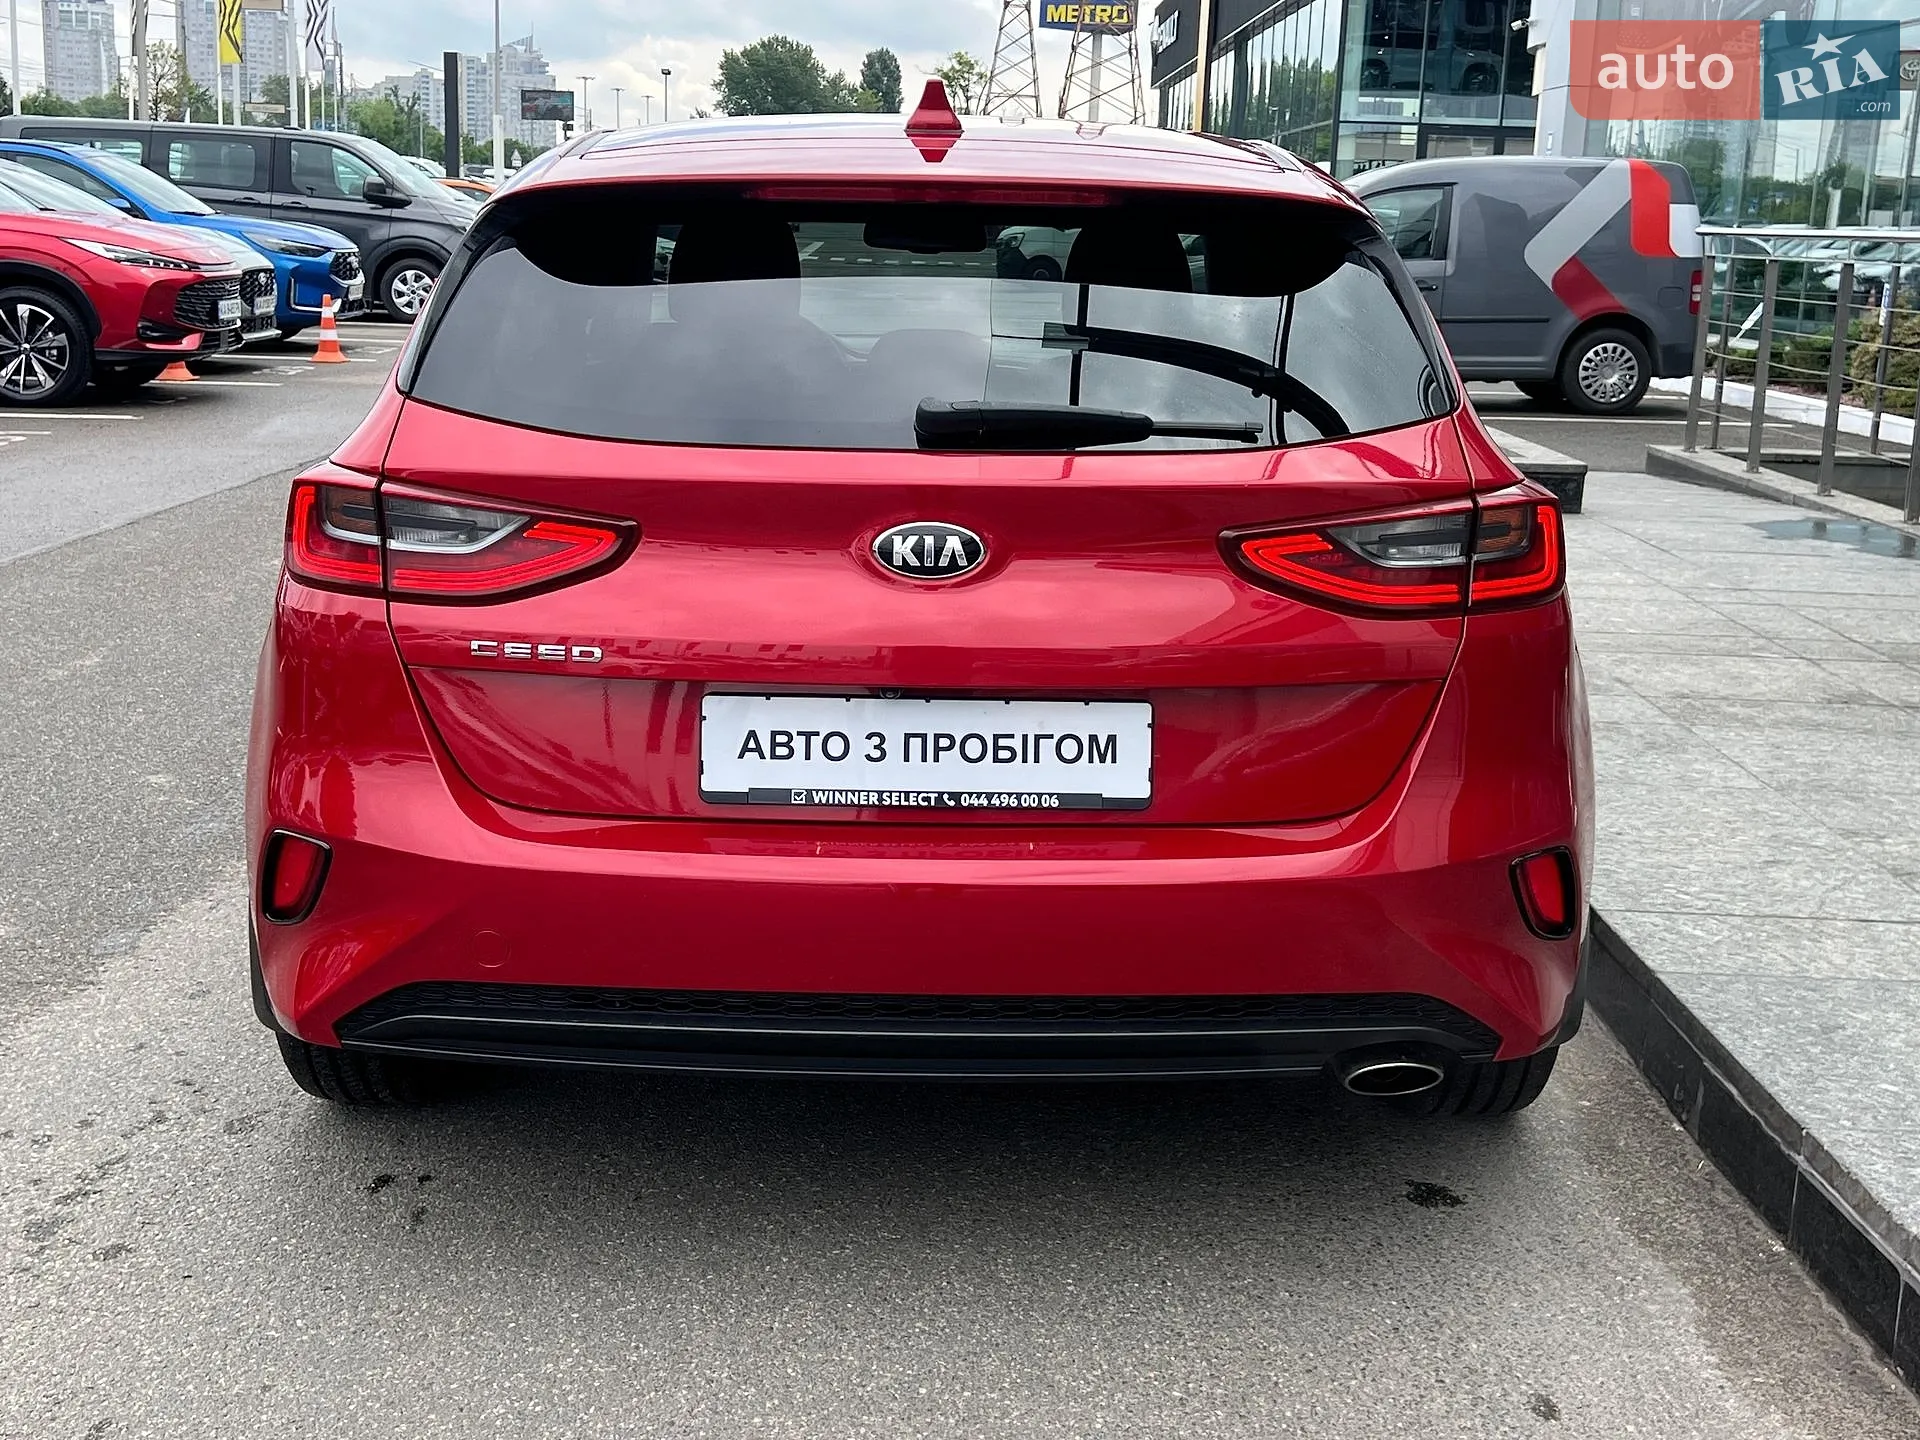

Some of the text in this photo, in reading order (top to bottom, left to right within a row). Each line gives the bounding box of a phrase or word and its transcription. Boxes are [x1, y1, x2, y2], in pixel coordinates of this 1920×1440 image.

[1046, 4, 1129, 24] METRO
[891, 535, 968, 567] KIA
[470, 640, 603, 662] CEED
[737, 729, 850, 762] АВТО
[902, 732, 1118, 764] ПРОБІГОМ
[811, 790, 1060, 808] WINNER SELECT 044 496 00 06
